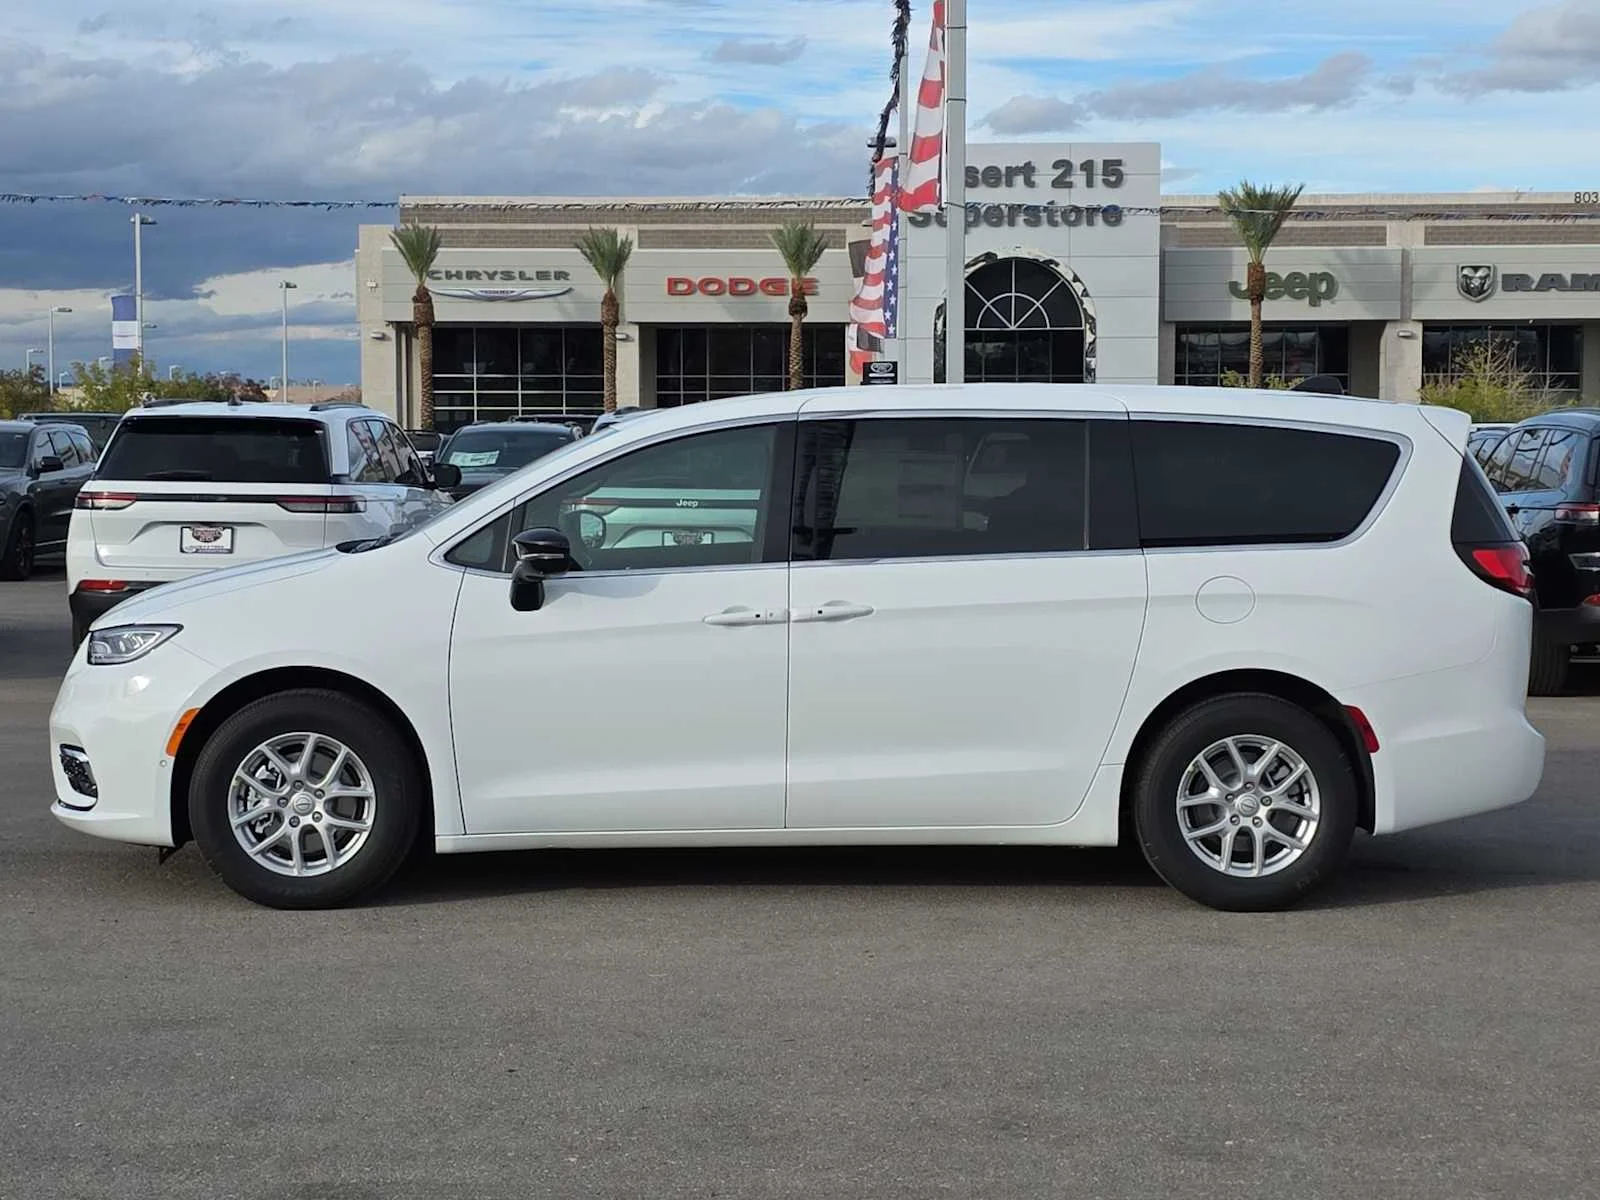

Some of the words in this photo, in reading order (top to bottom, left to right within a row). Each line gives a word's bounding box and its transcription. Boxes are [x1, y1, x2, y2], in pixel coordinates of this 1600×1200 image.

[965, 161, 1036, 188] sert
[1051, 159, 1124, 188] 215
[428, 270, 570, 281] CHRYSLER
[1502, 273, 1600, 292] RAM
[667, 277, 819, 296] DODGE
[676, 499, 698, 508] Jeep
